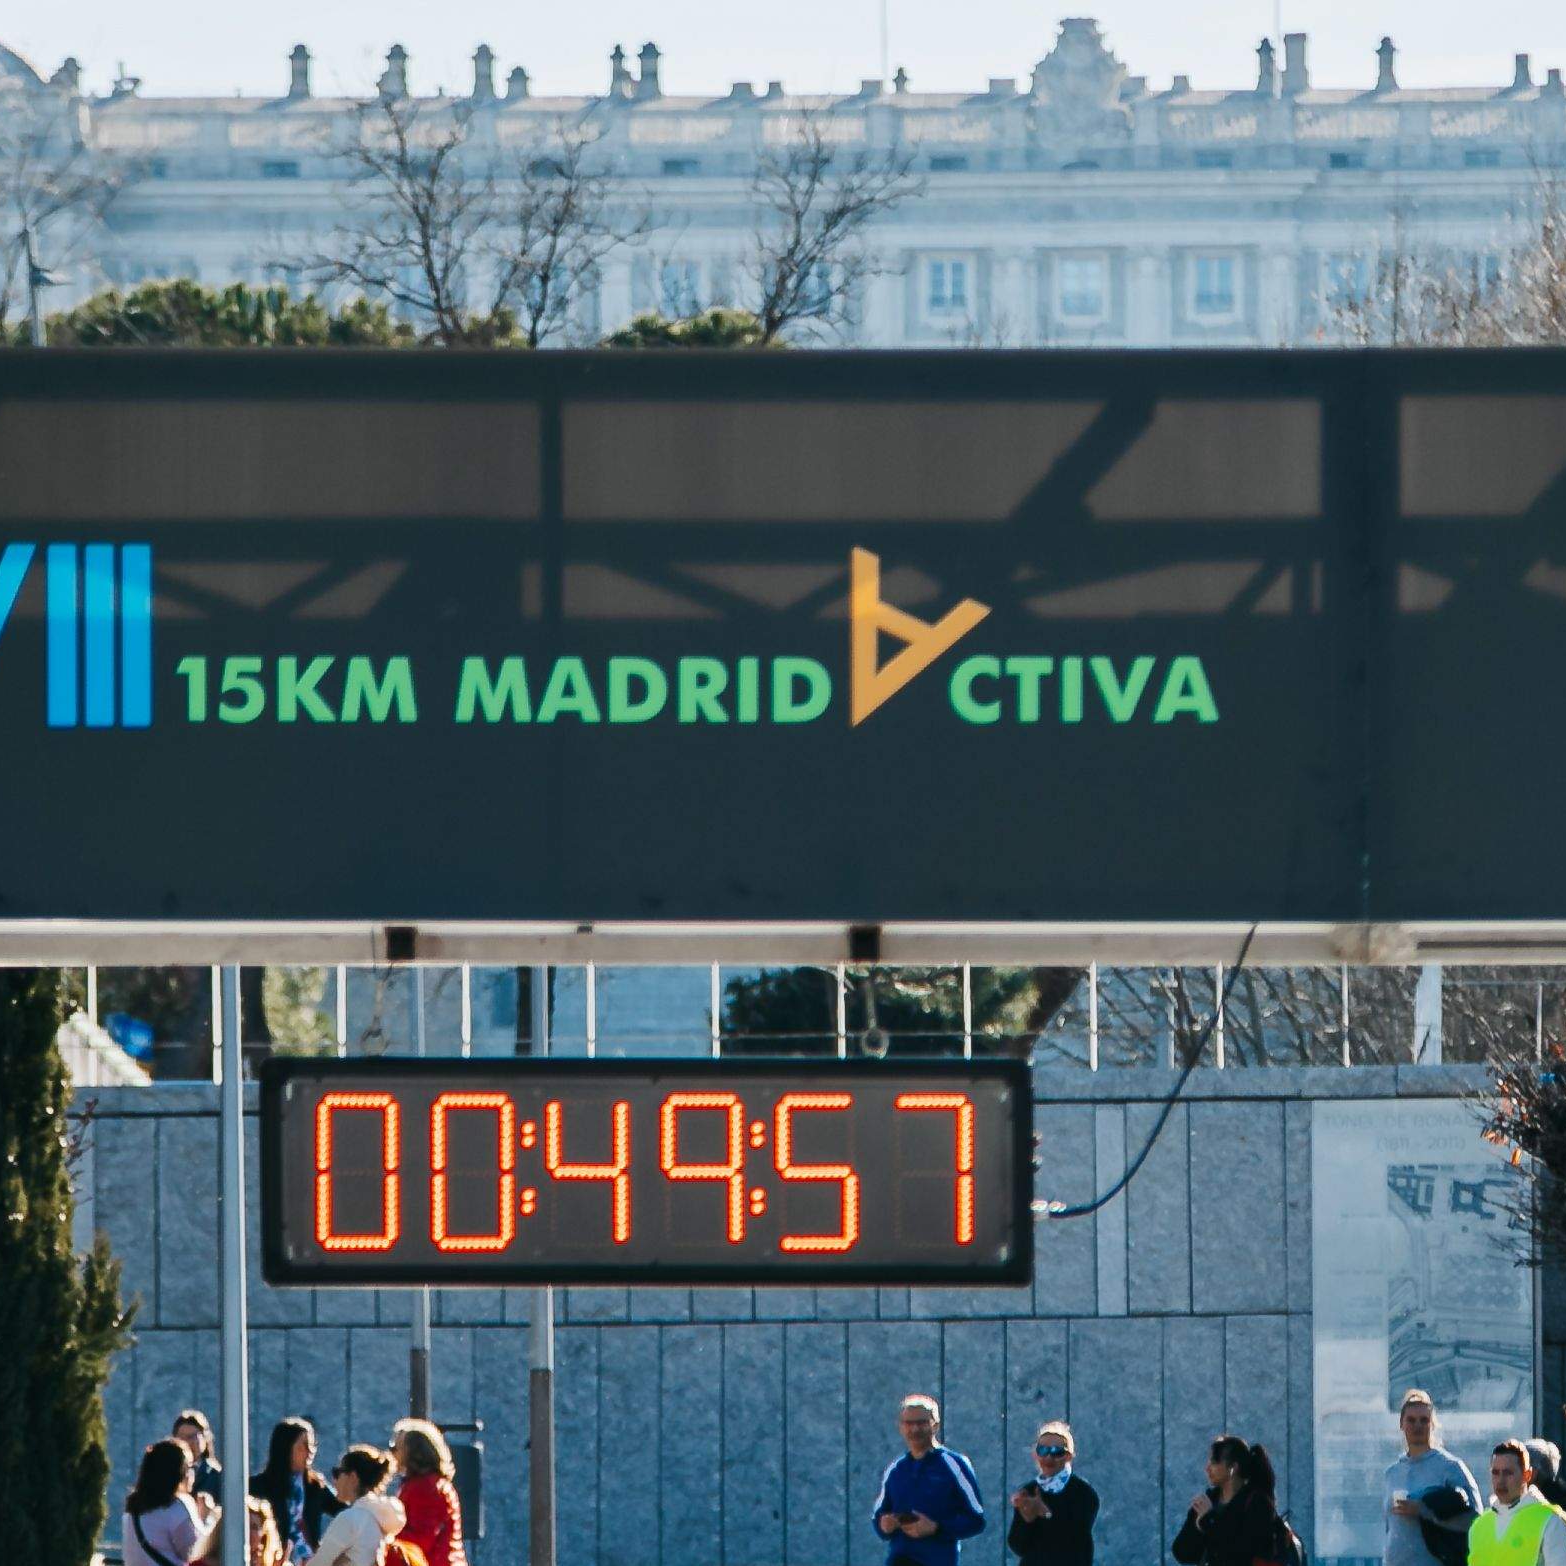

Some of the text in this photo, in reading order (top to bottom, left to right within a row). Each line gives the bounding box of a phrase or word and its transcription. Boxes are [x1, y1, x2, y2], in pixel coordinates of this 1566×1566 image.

[177, 655, 418, 723] 15KM
[455, 655, 832, 723] MADRID
[314, 1092, 975, 1252] 00:49:57
